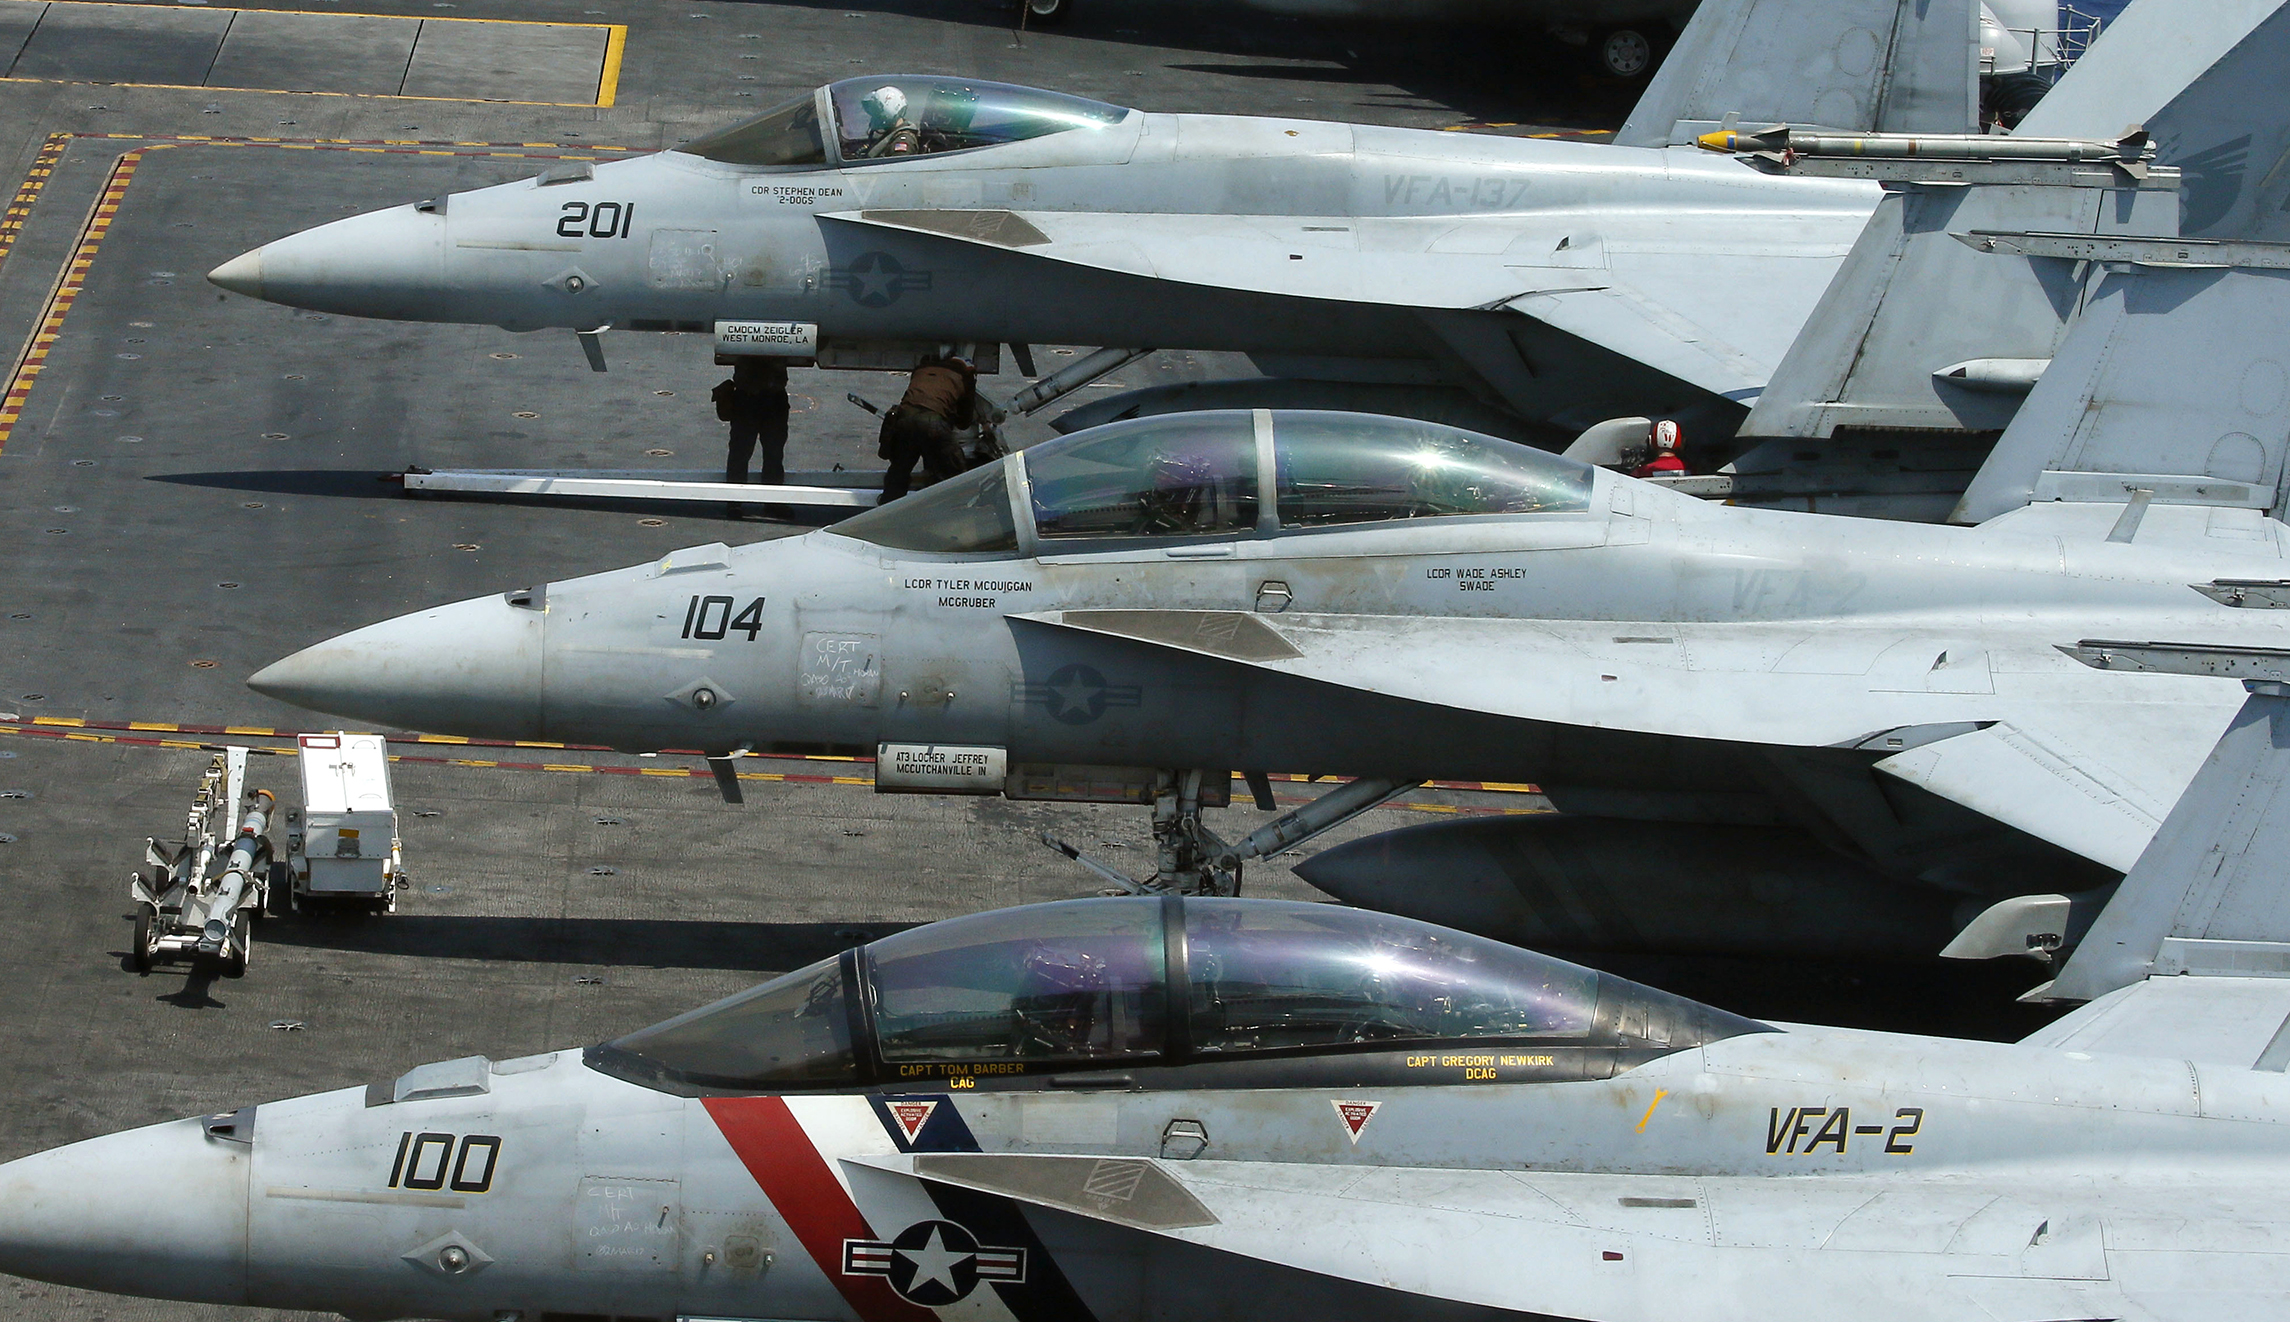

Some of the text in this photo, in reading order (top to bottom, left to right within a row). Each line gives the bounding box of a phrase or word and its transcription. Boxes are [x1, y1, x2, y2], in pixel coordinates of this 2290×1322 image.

[751, 186, 843, 197] CDR STEPHEN DEAN
[1383, 174, 1531, 209] VFA-137
[556, 202, 635, 239] 201
[764, 326, 804, 335] ZEIGLER
[722, 334, 809, 345] WEST MONROE, LA
[1426, 568, 1527, 579] LCDR WADE ASHLEY
[904, 579, 932, 589] LCDR
[936, 579, 970, 590] TYLER
[938, 597, 996, 608] MCGRUBER
[681, 595, 766, 641] 104
[816, 638, 861, 654] CERT
[896, 752, 989, 764] AT3 LOCHER JEFFREY
[896, 764, 987, 776] MCCUTCHANVILLE IN
[1406, 1055, 1554, 1067] CAPT GREGORY NEWKIRK
[900, 1063, 1024, 1076] CAPT TOM BARBER
[1465, 1067, 1497, 1080] DCAG
[950, 1076, 975, 1089] CAG
[1766, 1107, 1925, 1155] VFA-2
[388, 1131, 503, 1194] 100
[587, 1186, 634, 1200] CERT
